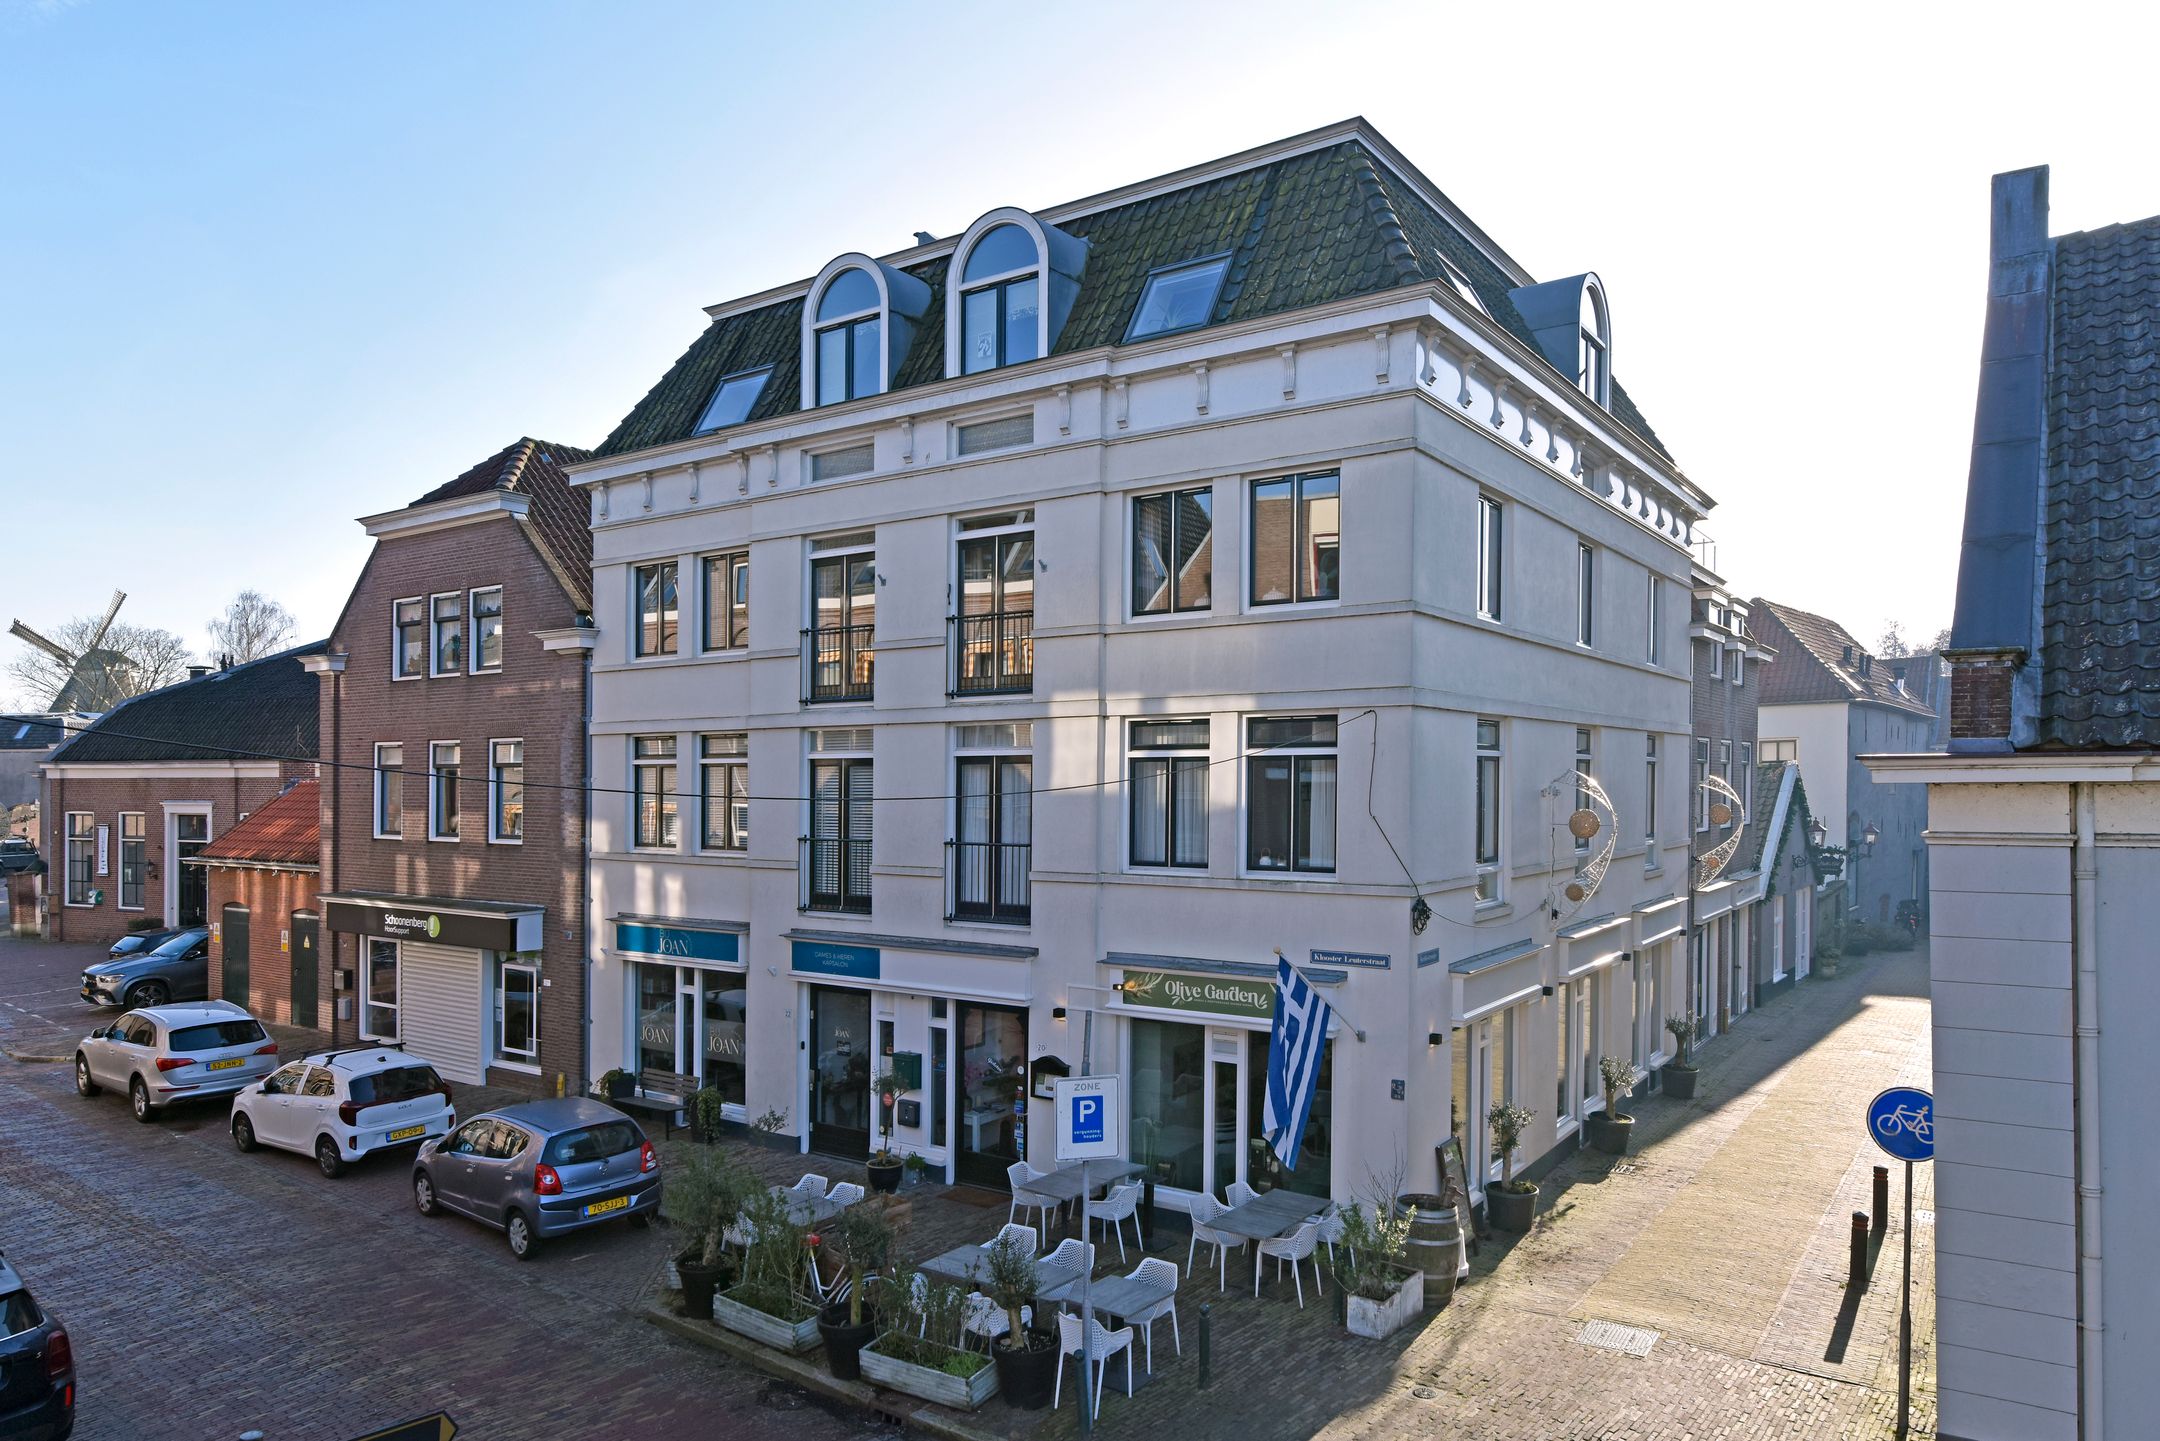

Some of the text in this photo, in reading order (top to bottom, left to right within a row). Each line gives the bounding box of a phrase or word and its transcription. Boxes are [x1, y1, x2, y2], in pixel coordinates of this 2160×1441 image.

[384, 914, 428, 931] Schoonenberg
[657, 938, 688, 955] JOAN
[1165, 980, 1268, 1010] Olive Garden
[640, 1026, 671, 1044] JOAN
[707, 1035, 740, 1055] JOAN
[1074, 1082, 1101, 1092] ZONE
[1079, 1099, 1096, 1123] P
[592, 1198, 626, 1213] 70-SJJ-3
